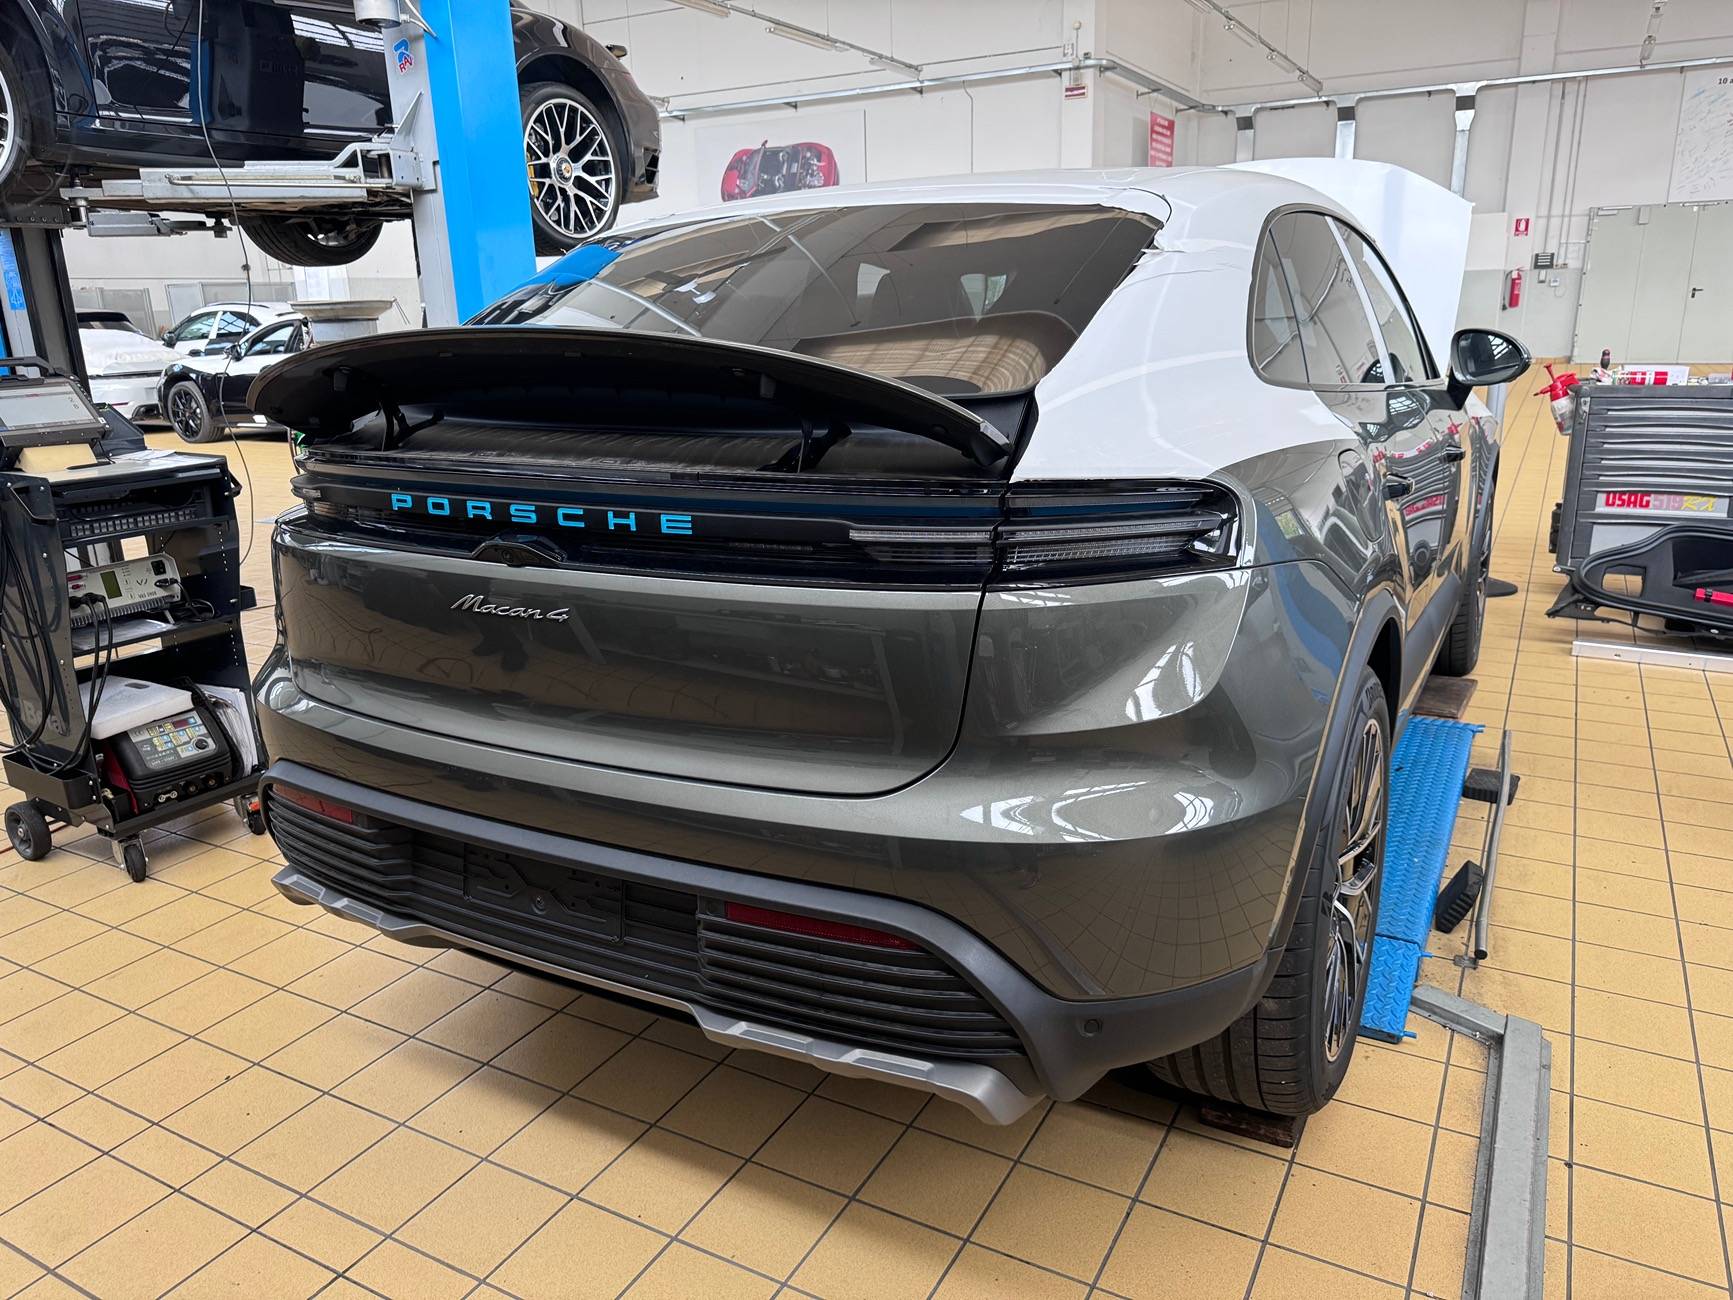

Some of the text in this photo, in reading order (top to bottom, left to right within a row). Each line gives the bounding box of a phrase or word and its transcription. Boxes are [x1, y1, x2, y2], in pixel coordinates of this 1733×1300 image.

[391, 493, 693, 535] PORSCHE
[1605, 493, 1652, 509] USAG
[450, 594, 570, 623] Macan 4
